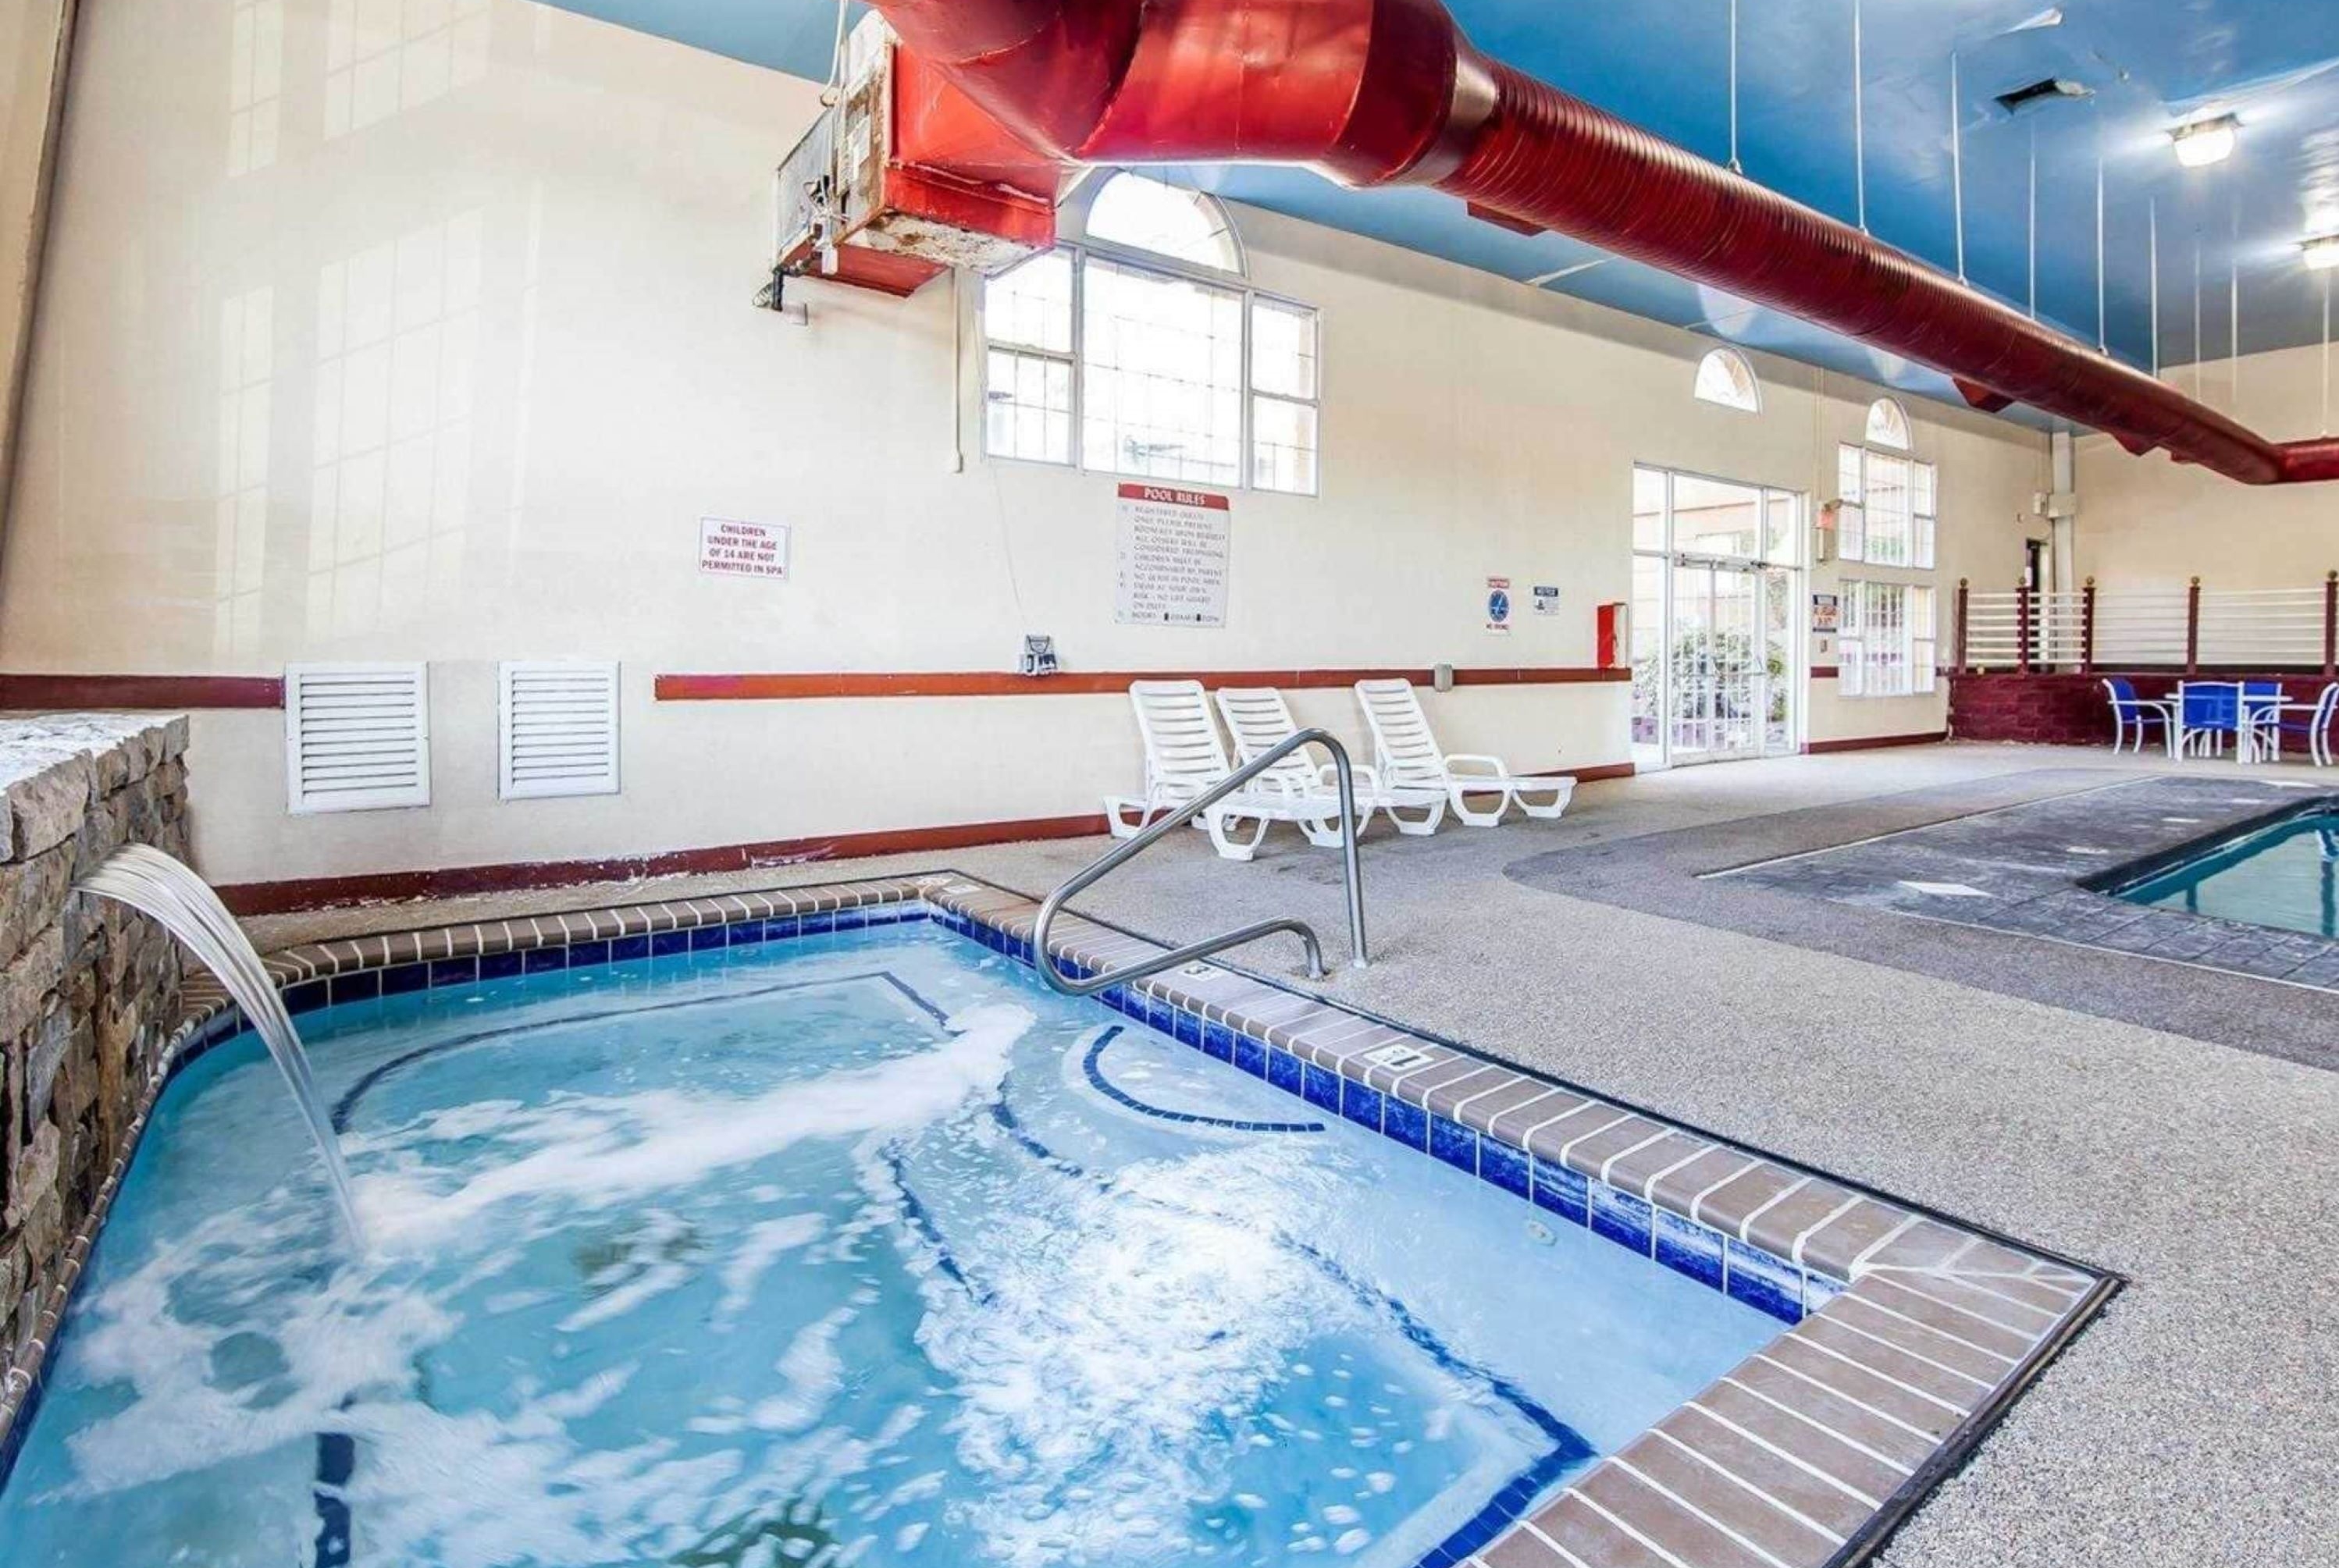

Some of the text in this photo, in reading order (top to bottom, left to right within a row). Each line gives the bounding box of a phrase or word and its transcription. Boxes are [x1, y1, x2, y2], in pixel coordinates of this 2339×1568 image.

[1145, 487, 1206, 505] POOL RULES
[721, 524, 766, 536] CHILDREN
[707, 535, 777, 550] UNDER THE AGE
[709, 548, 774, 561] OF 14 ARE NOT
[702, 560, 752, 572] PERMITTED
[766, 566, 782, 574] SPA
